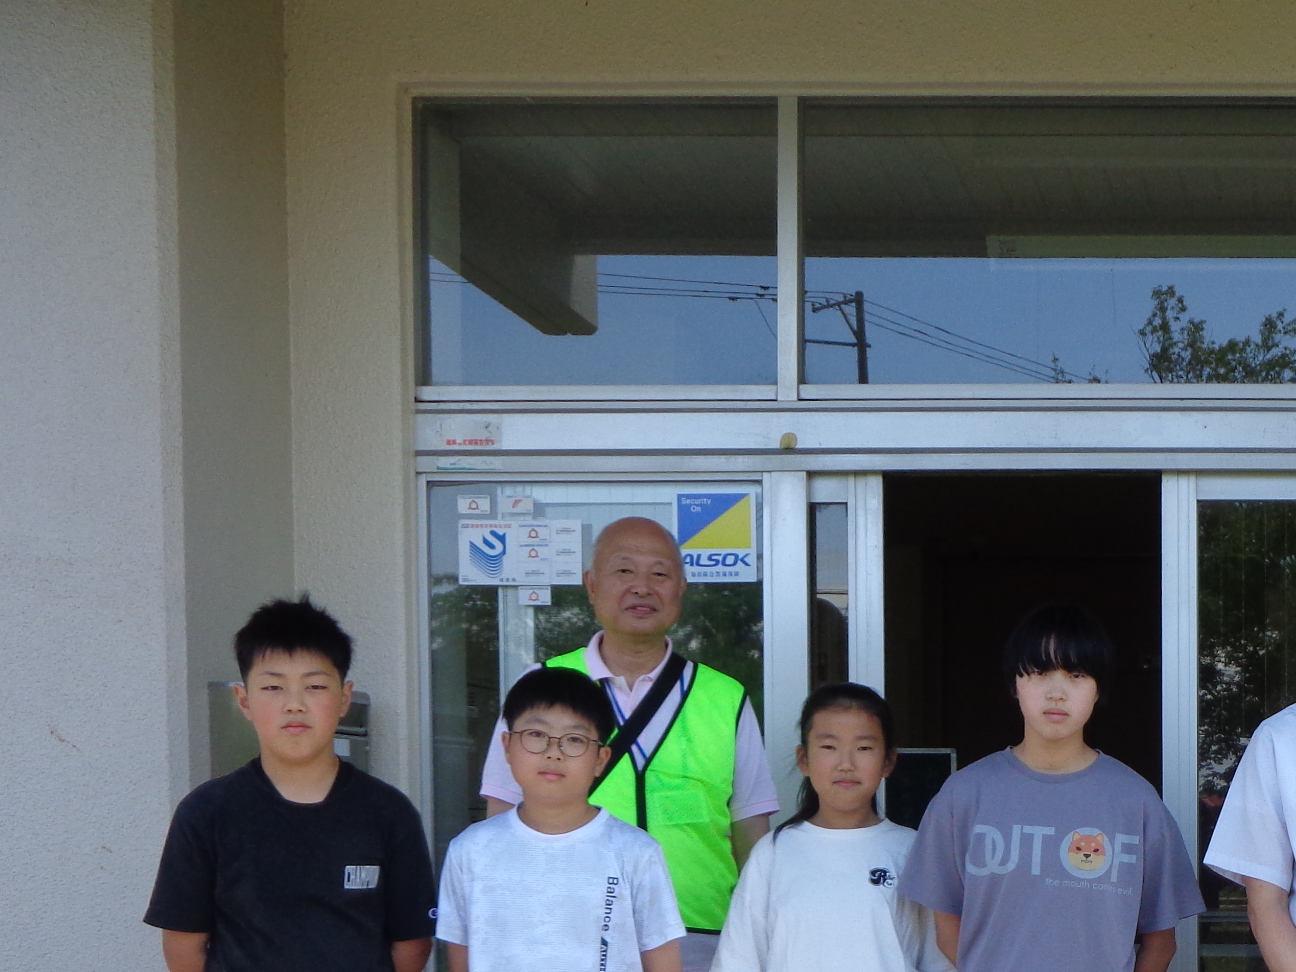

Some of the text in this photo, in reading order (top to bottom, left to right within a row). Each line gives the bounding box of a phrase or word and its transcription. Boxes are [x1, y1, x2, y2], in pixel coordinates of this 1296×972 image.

[681, 497, 712, 505] Security
[683, 553, 752, 567] ALSOK
[966, 824, 1055, 876] OUT
[601, 876, 619, 931] Balance
